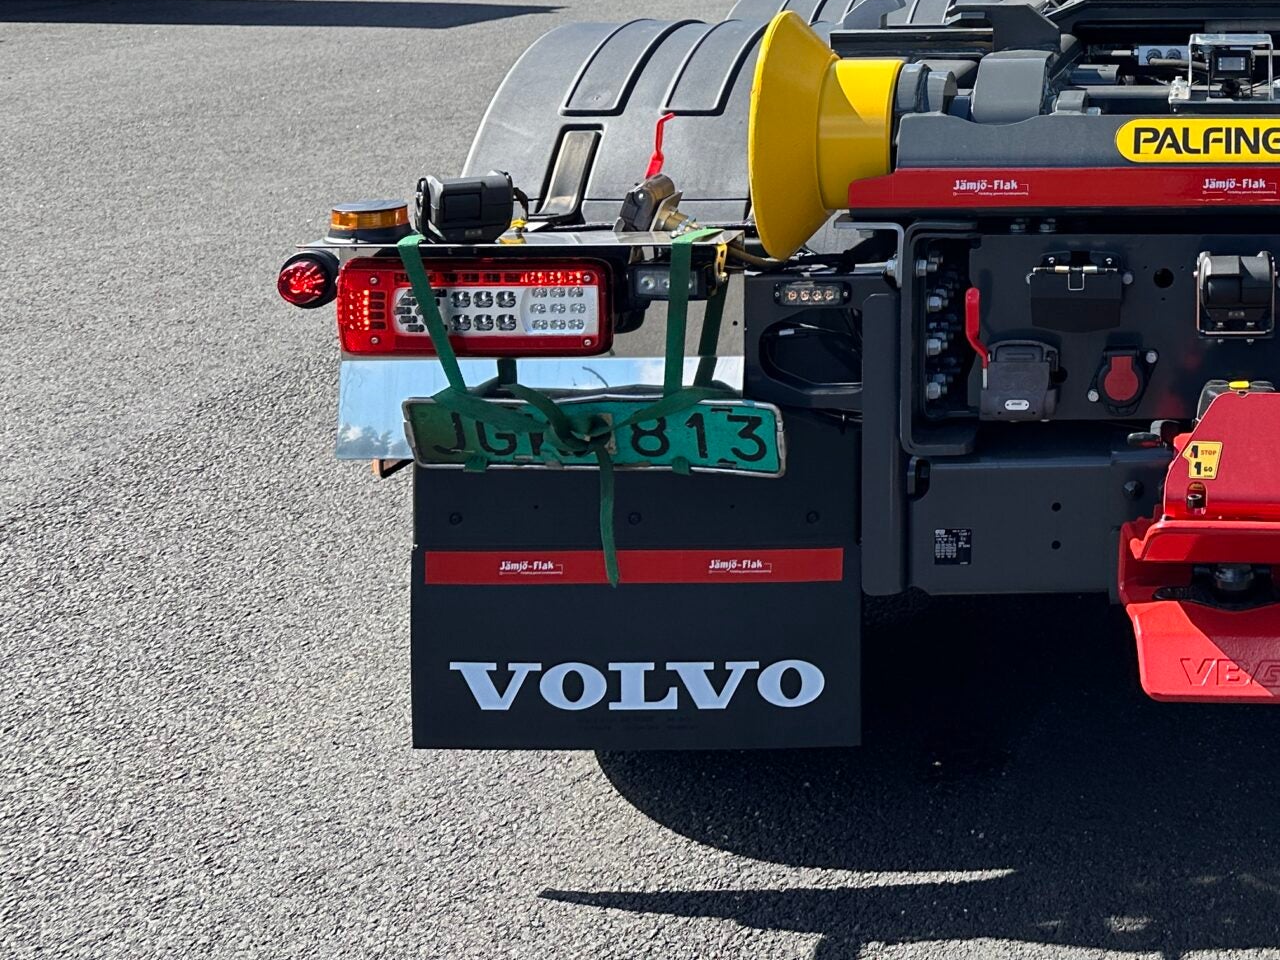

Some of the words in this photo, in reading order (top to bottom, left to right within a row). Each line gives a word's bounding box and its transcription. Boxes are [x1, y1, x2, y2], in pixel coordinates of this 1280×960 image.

[953, 179, 1018, 192] Jämjö-Flak
[1202, 178, 1266, 191] Jämjö-Flak
[631, 412, 767, 462] 813
[499, 560, 554, 572] Jämjö-Flak
[708, 559, 763, 571] Jämjö-Flak
[449, 659, 825, 711] VOLVO
